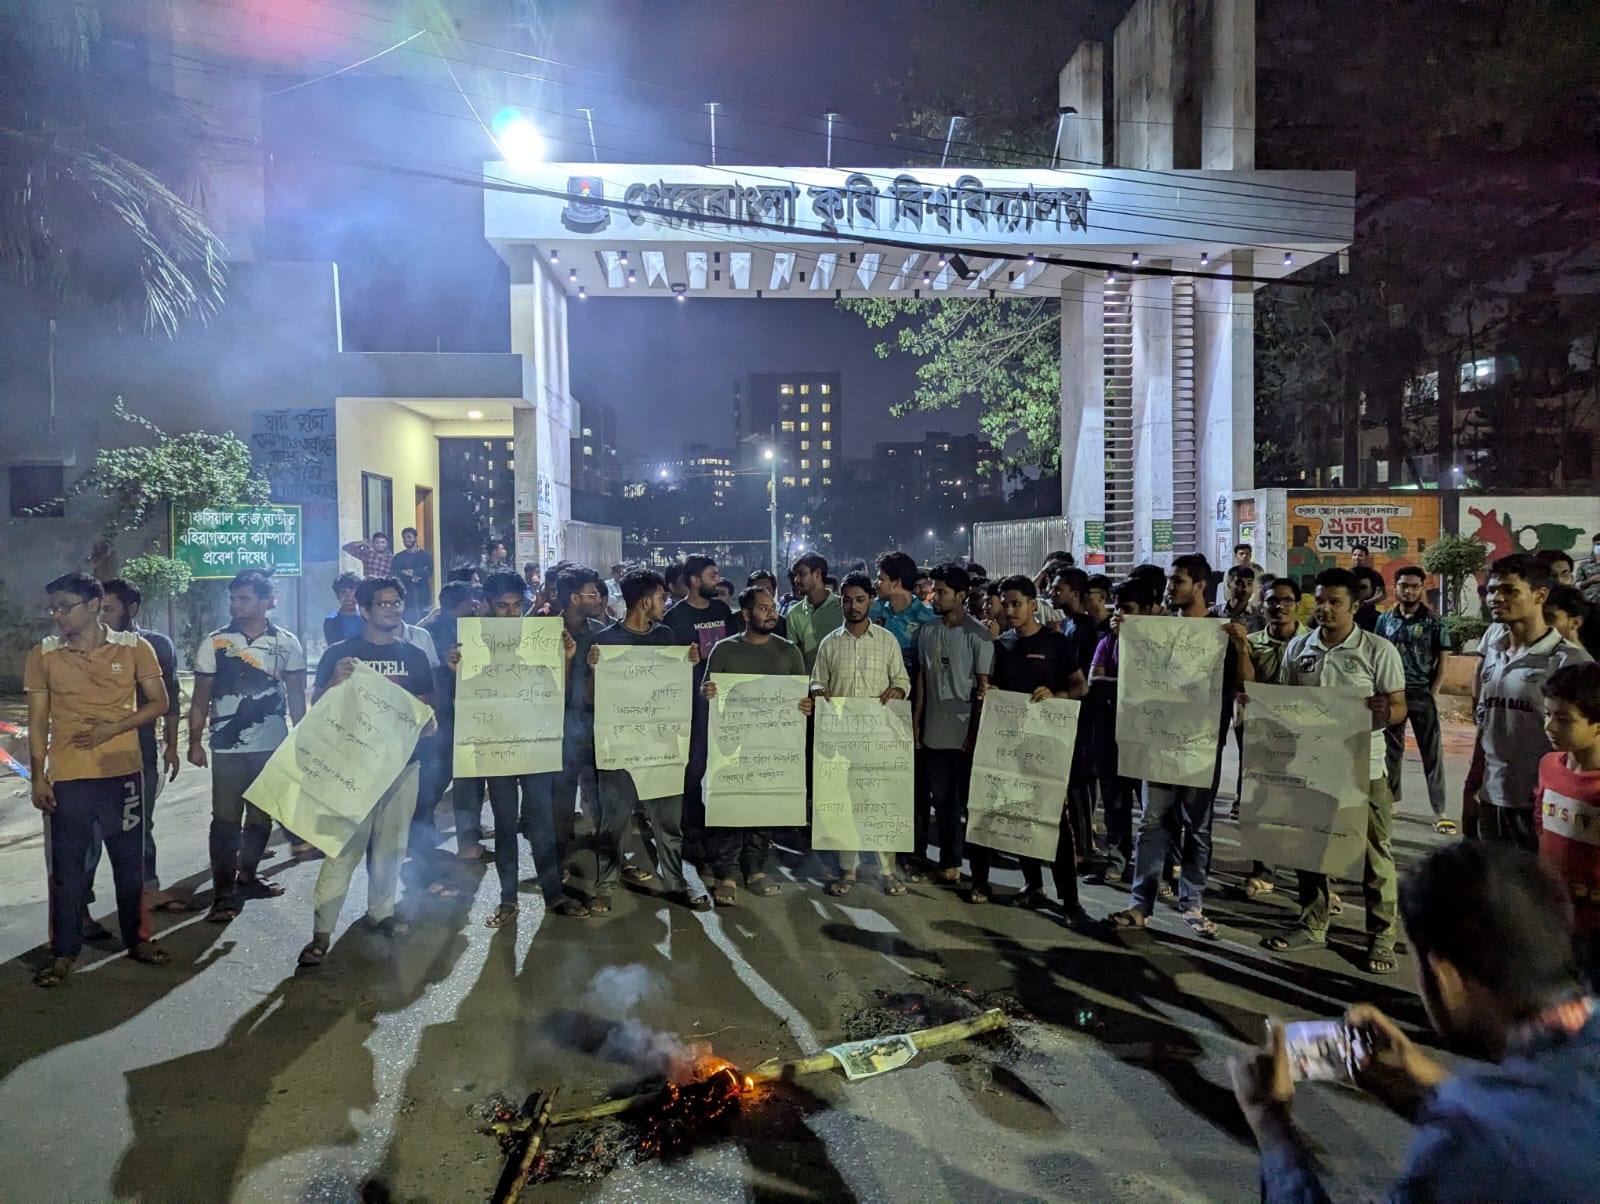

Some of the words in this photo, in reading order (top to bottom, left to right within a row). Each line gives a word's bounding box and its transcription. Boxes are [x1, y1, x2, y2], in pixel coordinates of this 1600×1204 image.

[807, 173, 881, 234] কৃষি
[894, 173, 1092, 234] বিশ্ববিদ্যালয়
[180, 508, 234, 526] ফিসিয়াল
[263, 508, 296, 526] ব্যতীত
[1328, 517, 1384, 534] গুজবে
[179, 527, 247, 545] বহিরাগতদের
[250, 531, 296, 545] ক্যাম্পাসে
[1318, 535, 1344, 550] সব
[203, 550, 234, 565] প্রবেশ
